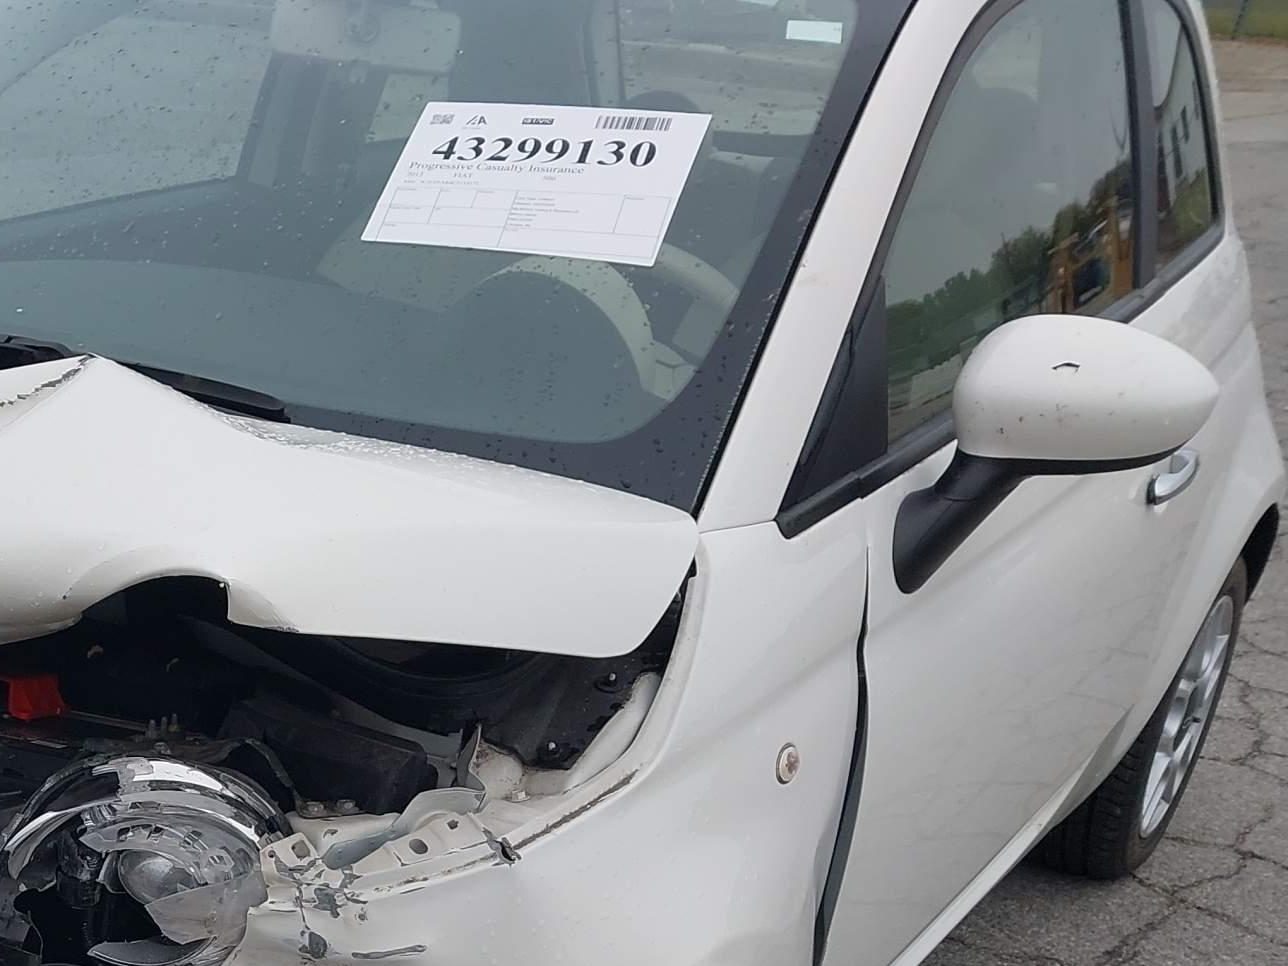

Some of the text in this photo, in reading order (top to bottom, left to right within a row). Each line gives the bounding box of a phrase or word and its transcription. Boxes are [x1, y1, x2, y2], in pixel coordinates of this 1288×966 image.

[431, 136, 657, 167] 43299130
[408, 161, 585, 174] Progressive Casualty Insurance
